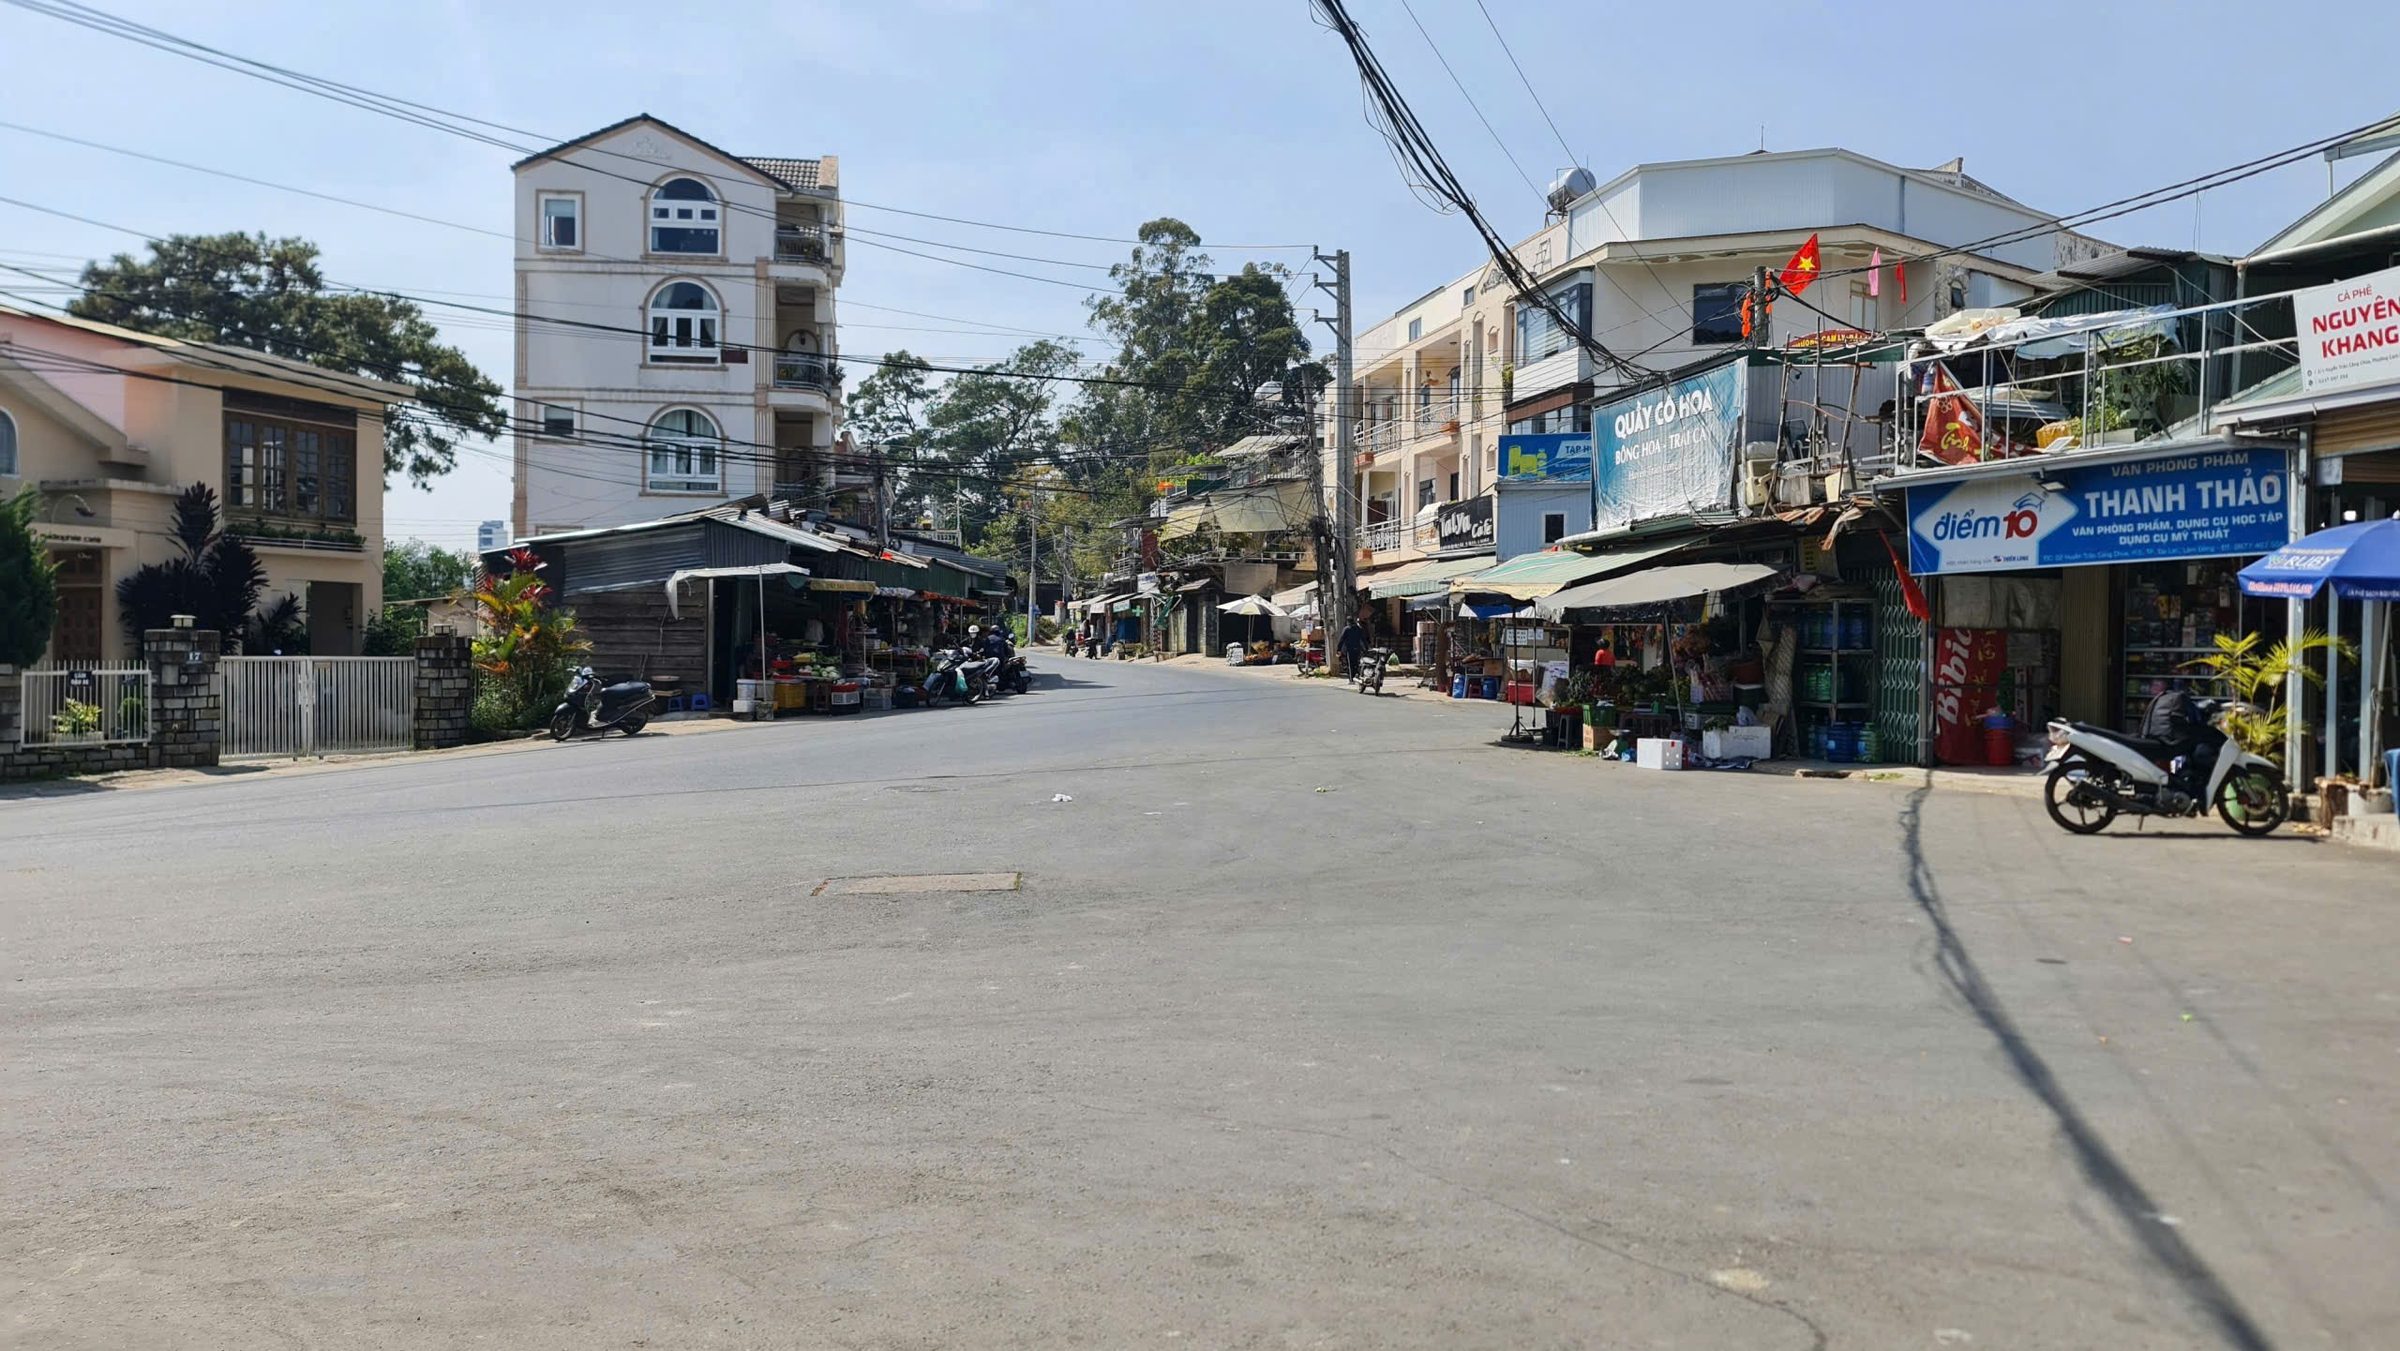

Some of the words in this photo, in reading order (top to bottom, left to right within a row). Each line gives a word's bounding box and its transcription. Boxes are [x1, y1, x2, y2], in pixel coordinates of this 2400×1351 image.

[2337, 289, 2351, 302] CÀ
[2352, 284, 2373, 299] PHÊ
[2312, 295, 2400, 335] NGUYÊN
[2321, 325, 2400, 359] KHANG
[1654, 394, 1676, 426] CÔ
[1680, 386, 1714, 419] HOA
[1641, 438, 1661, 457] HOA
[2085, 483, 2186, 519] THANH
[2196, 468, 2282, 510] THẢO
[1933, 508, 2000, 541] điểm
[2003, 509, 2038, 540] 10
[2096, 520, 2135, 535] PHÒNG
[2176, 516, 2209, 531] DỤNG
[2212, 515, 2229, 529] CỤ
[2231, 514, 2257, 528] HỌC
[2118, 533, 2150, 548] DỤNG
[2152, 532, 2169, 545] CỤ
[2191, 528, 2231, 541] THUẬT
[2284, 555, 2340, 568] RUBY
[188, 651, 201, 661] 17
